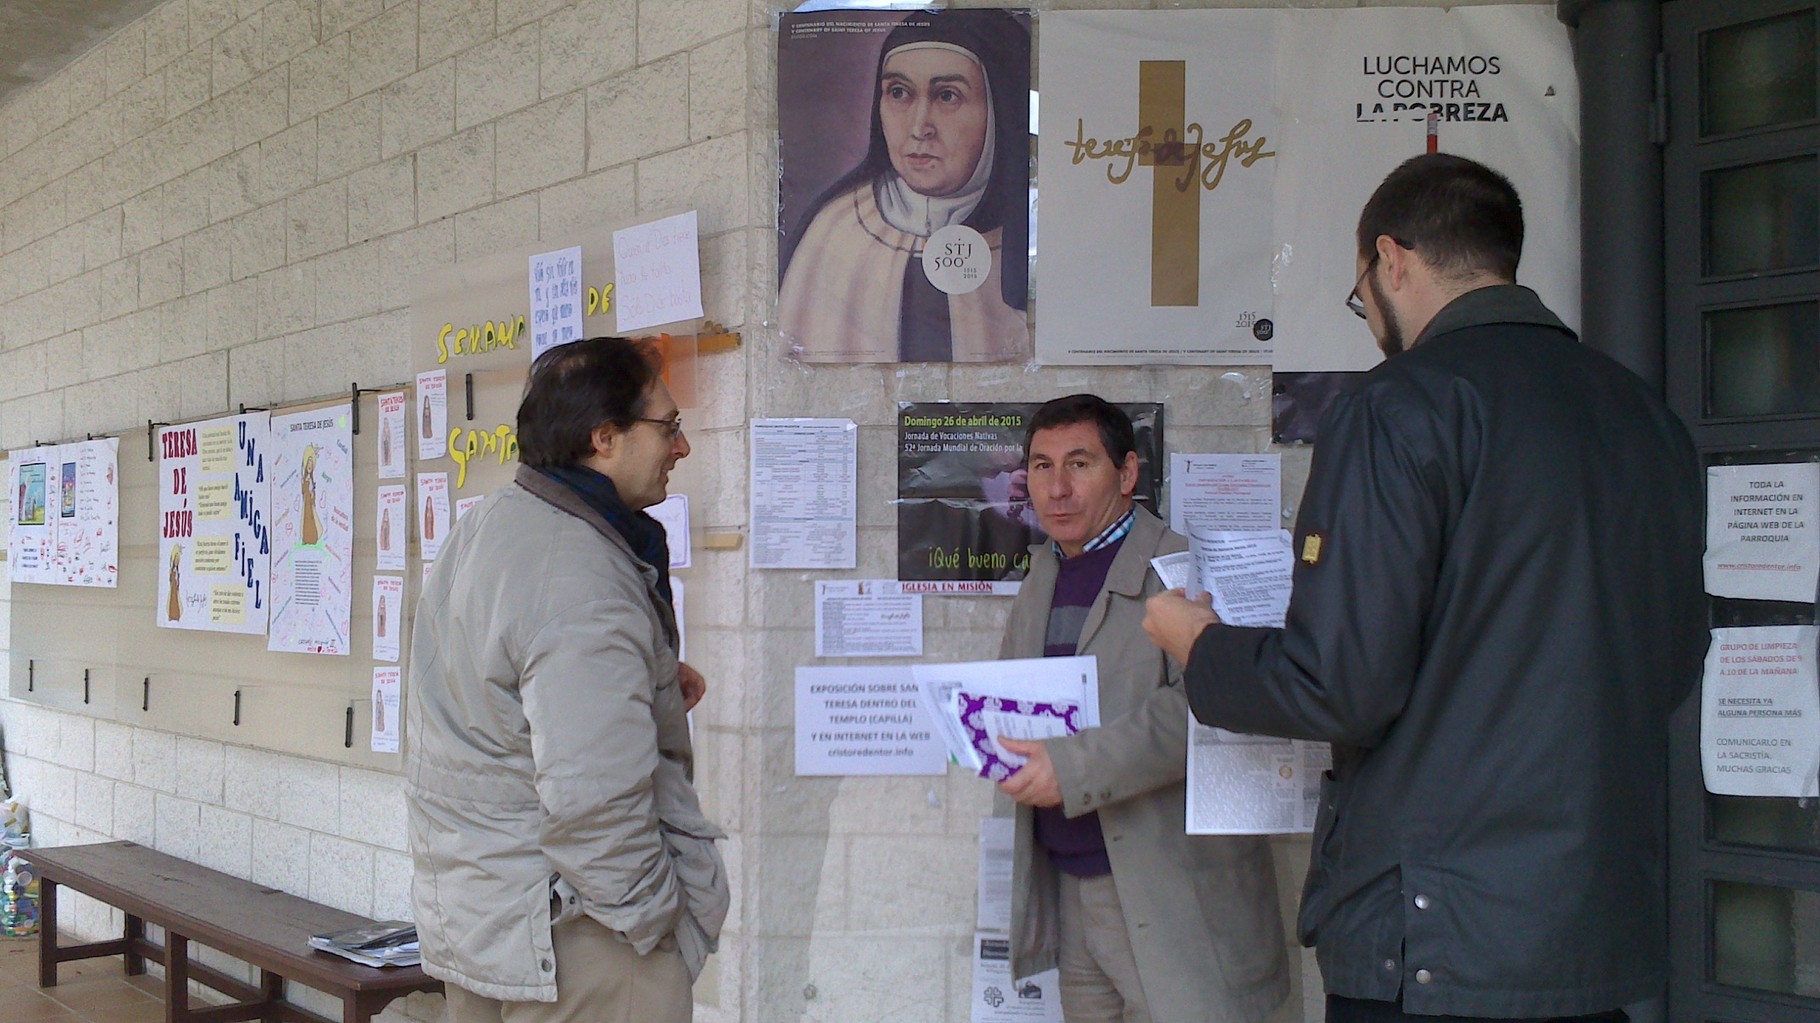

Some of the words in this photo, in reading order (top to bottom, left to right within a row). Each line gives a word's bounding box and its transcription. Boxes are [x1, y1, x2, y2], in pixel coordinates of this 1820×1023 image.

[1363, 55, 1502, 76] LUCHAMOS
[1377, 79, 1481, 99] CONTRA
[944, 238, 973, 259] STJ
[934, 256, 964, 272] 500
[586, 283, 615, 318] DE
[904, 415, 943, 429] Domingo
[943, 415, 955, 426] 26
[956, 415, 967, 426] de
[968, 415, 988, 426] abril
[989, 415, 1000, 426] de
[1001, 415, 1022, 426] 2015
[904, 432, 929, 441] Jornada
[930, 431, 938, 441] de
[939, 431, 974, 441] Vocaciones
[975, 431, 998, 441] Nativas
[162, 427, 198, 460] TERESA
[917, 443, 942, 454] Jornada
[943, 443, 968, 452] Mundial
[969, 443, 978, 452] de
[979, 442, 1003, 452] Oración
[1004, 444, 1015, 454] por
[239, 420, 264, 484] UNA
[449, 424, 519, 490] SANTA
[173, 466, 187, 496] DE
[1749, 481, 1772, 489] TODA
[1774, 480, 1785, 489] LA
[1730, 493, 1790, 503] INFORMACIÓN
[1792, 493, 1804, 502] EN
[1733, 507, 1774, 516] INTERNET
[1775, 507, 1787, 516] EN
[1788, 507, 1799, 515] LA
[163, 498, 193, 539] JESÚS
[1727, 520, 1759, 530] PÁGINA
[1761, 521, 1779, 530] WEB
[1781, 521, 1793, 529] DE
[1794, 521, 1805, 529] LA
[1740, 535, 1790, 543] PARROQUIA
[967, 547, 1007, 569] bueno
[902, 582, 938, 593] IGLESIA
[942, 582, 954, 593] EN
[958, 580, 993, 593] MISIÓN
[1720, 643, 1748, 652] GRUPO
[1749, 643, 1760, 651] DE
[1761, 642, 1798, 651] LIMPIEZA
[1720, 656, 1731, 664] DE
[1786, 655, 1796, 663] DE
[1727, 668, 1737, 676] 10
[1737, 668, 1748, 676] DE
[1761, 666, 1798, 676] MAÑANA
[810, 683, 866, 694] EXPOSICIÓN
[868, 684, 897, 693] SOBRE
[825, 699, 858, 709] TERESA
[860, 699, 898, 709] DENTRO
[900, 699, 917, 708] DEL
[1718, 698, 1727, 706] SE
[1727, 698, 1762, 706] NECESITA
[1763, 698, 1774, 706] YA
[829, 714, 867, 724] TEMPLO
[869, 714, 913, 725] (CAPILLA)
[1717, 710, 1747, 718] ALGUNA
[1749, 710, 1783, 718] PERSONA
[811, 732, 817, 742] Y
[819, 732, 832, 742] EN
[834, 732, 878, 742] INTERNET
[881, 732, 894, 741] EN
[896, 731, 907, 740] LA
[909, 731, 931, 740] WEB
[1716, 738, 1778, 747] COMUNICARLO
[1780, 738, 1792, 747] EN
[828, 747, 914, 757] cristoredentor.info
[1717, 751, 1728, 760] LA
[1716, 764, 1754, 773] MUCHAS
[1756, 765, 1792, 774] GRACIAS
